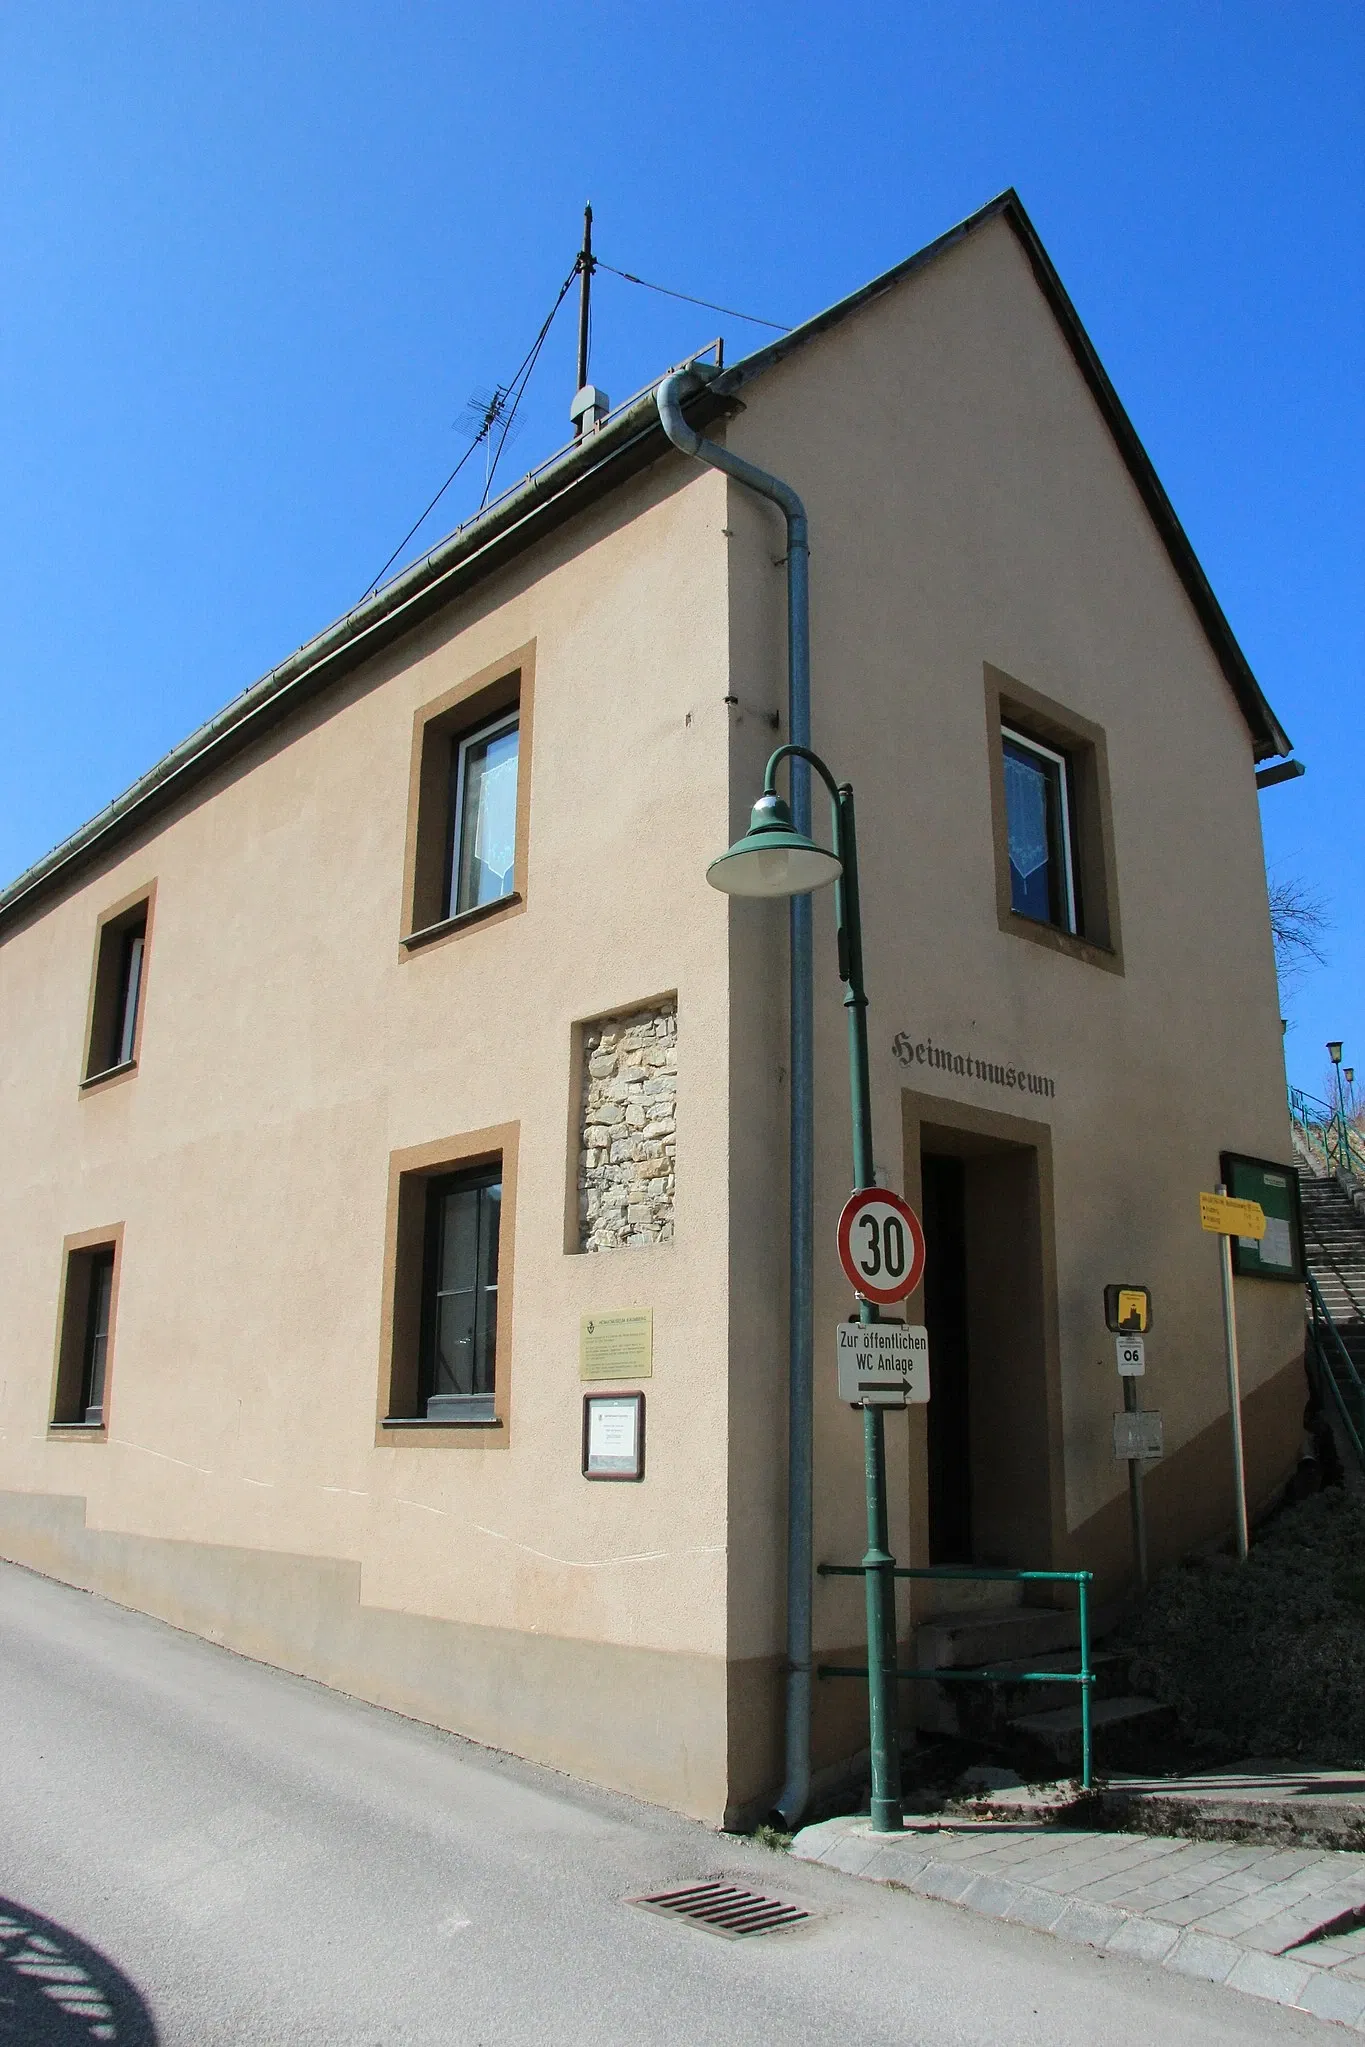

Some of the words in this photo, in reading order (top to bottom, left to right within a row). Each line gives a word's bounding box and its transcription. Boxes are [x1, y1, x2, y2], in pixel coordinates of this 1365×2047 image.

[891, 1031, 1056, 1098] Heimatmuseum
[858, 1213, 905, 1278] 30
[840, 1330, 859, 1349] Zur
[863, 1331, 927, 1351] öffentlichen
[856, 1353, 874, 1371] WC
[877, 1354, 914, 1376] Anlage
[1123, 1349, 1139, 1362] 06
